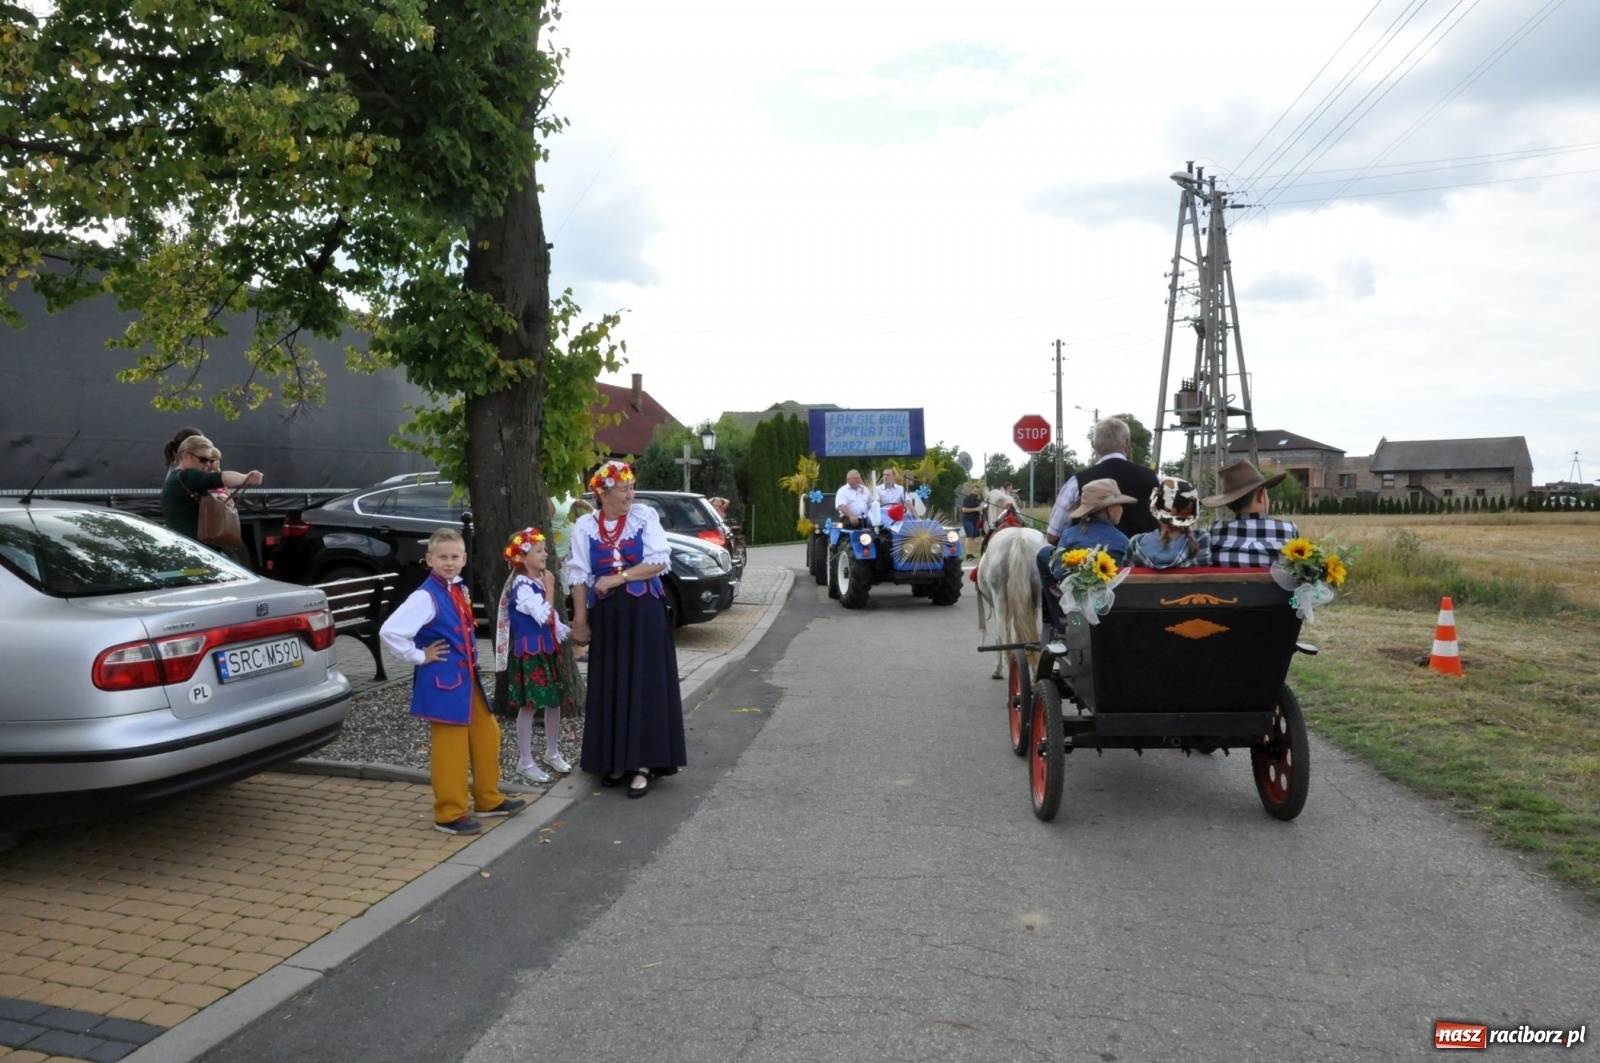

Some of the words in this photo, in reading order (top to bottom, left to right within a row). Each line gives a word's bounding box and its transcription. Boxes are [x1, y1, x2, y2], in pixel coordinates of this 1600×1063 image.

[1017, 427, 1048, 440] STOP
[827, 441, 870, 453] DOBRZE
[874, 440, 909, 452] MIEWA
[228, 648, 263, 674] SRC
[265, 640, 300, 666] M590
[193, 686, 209, 701] PL
